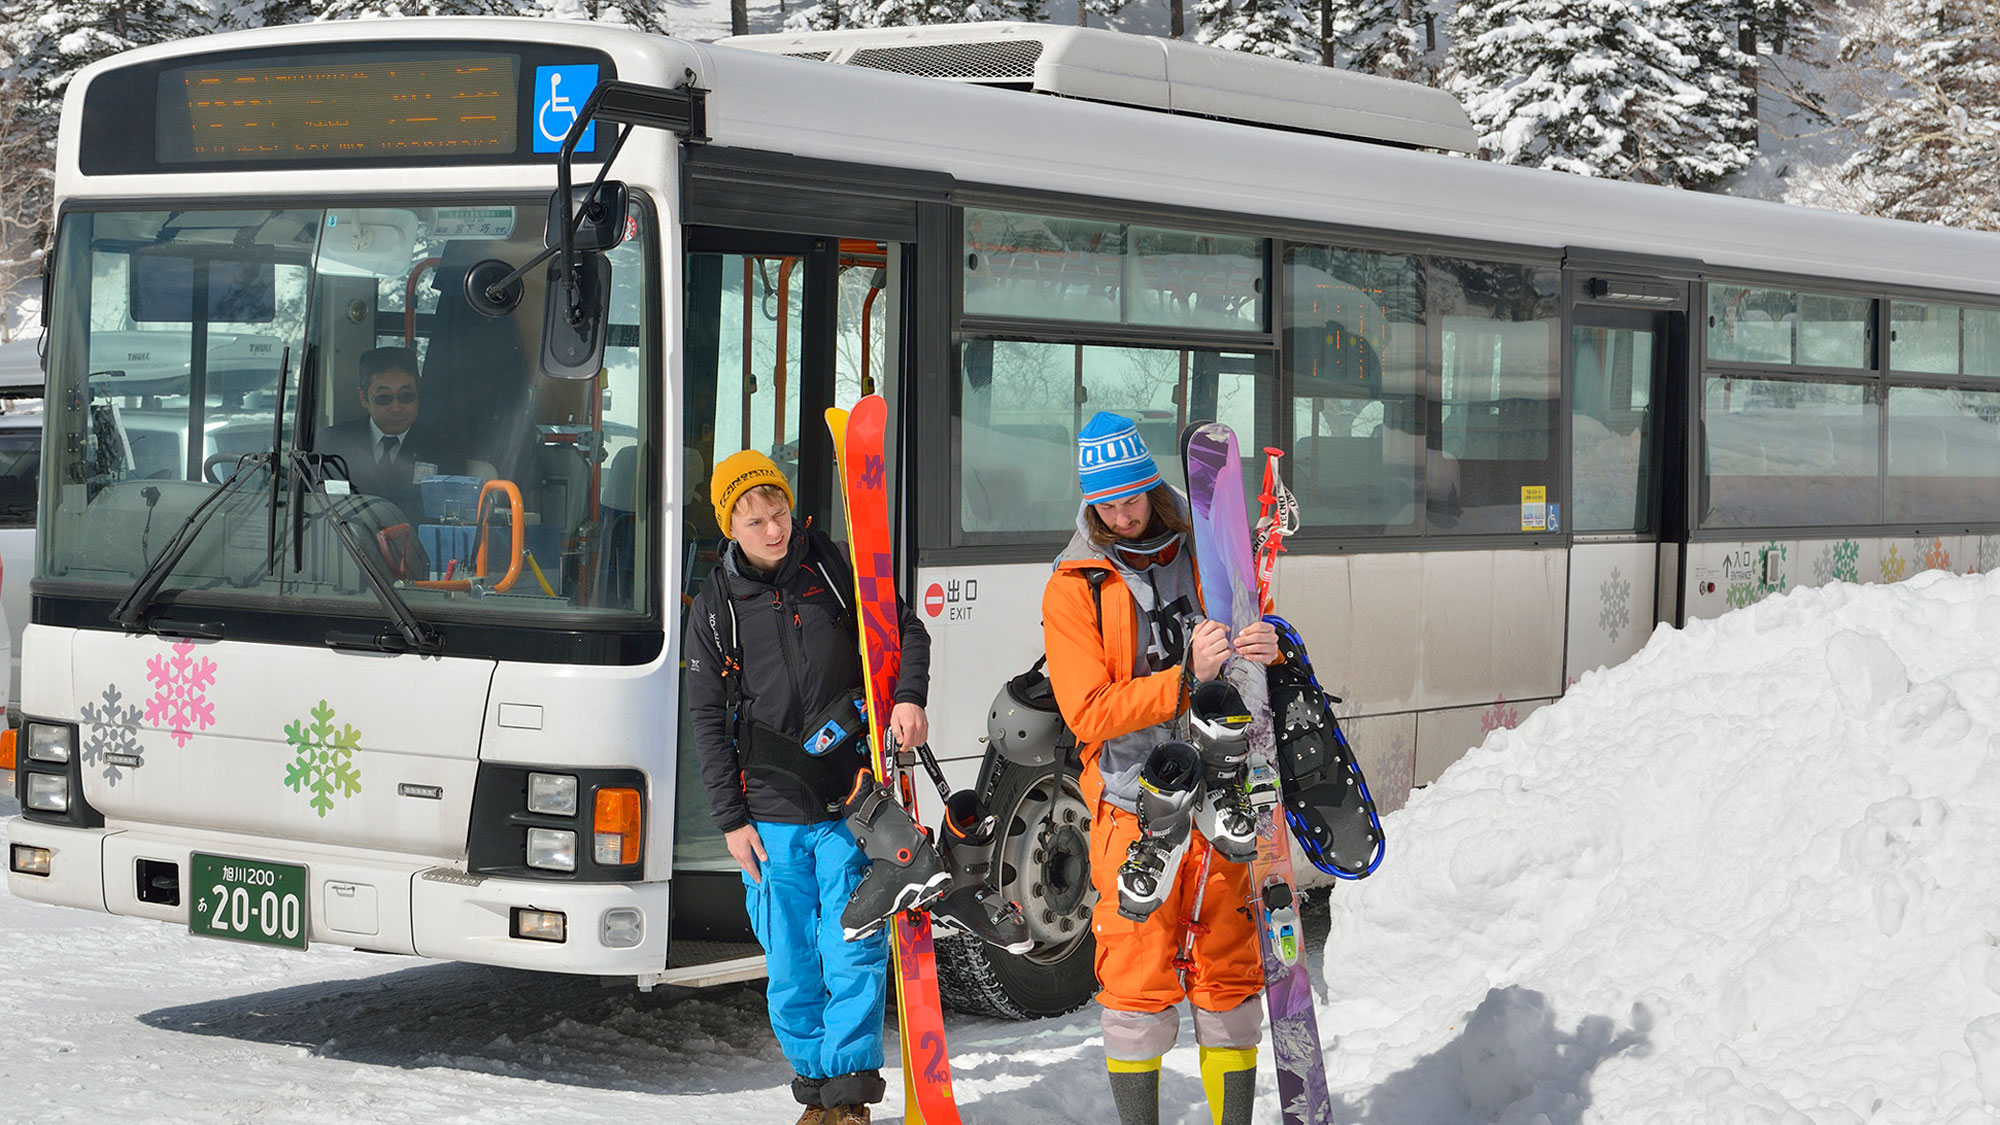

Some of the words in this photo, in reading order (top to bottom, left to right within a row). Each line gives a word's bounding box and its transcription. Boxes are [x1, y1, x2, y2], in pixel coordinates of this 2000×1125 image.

[1734, 551, 1751, 568] 入口
[947, 578, 978, 603] 出口
[950, 607, 973, 620] EXIT
[197, 897, 208, 913] あ
[211, 884, 300, 939] 20-00
